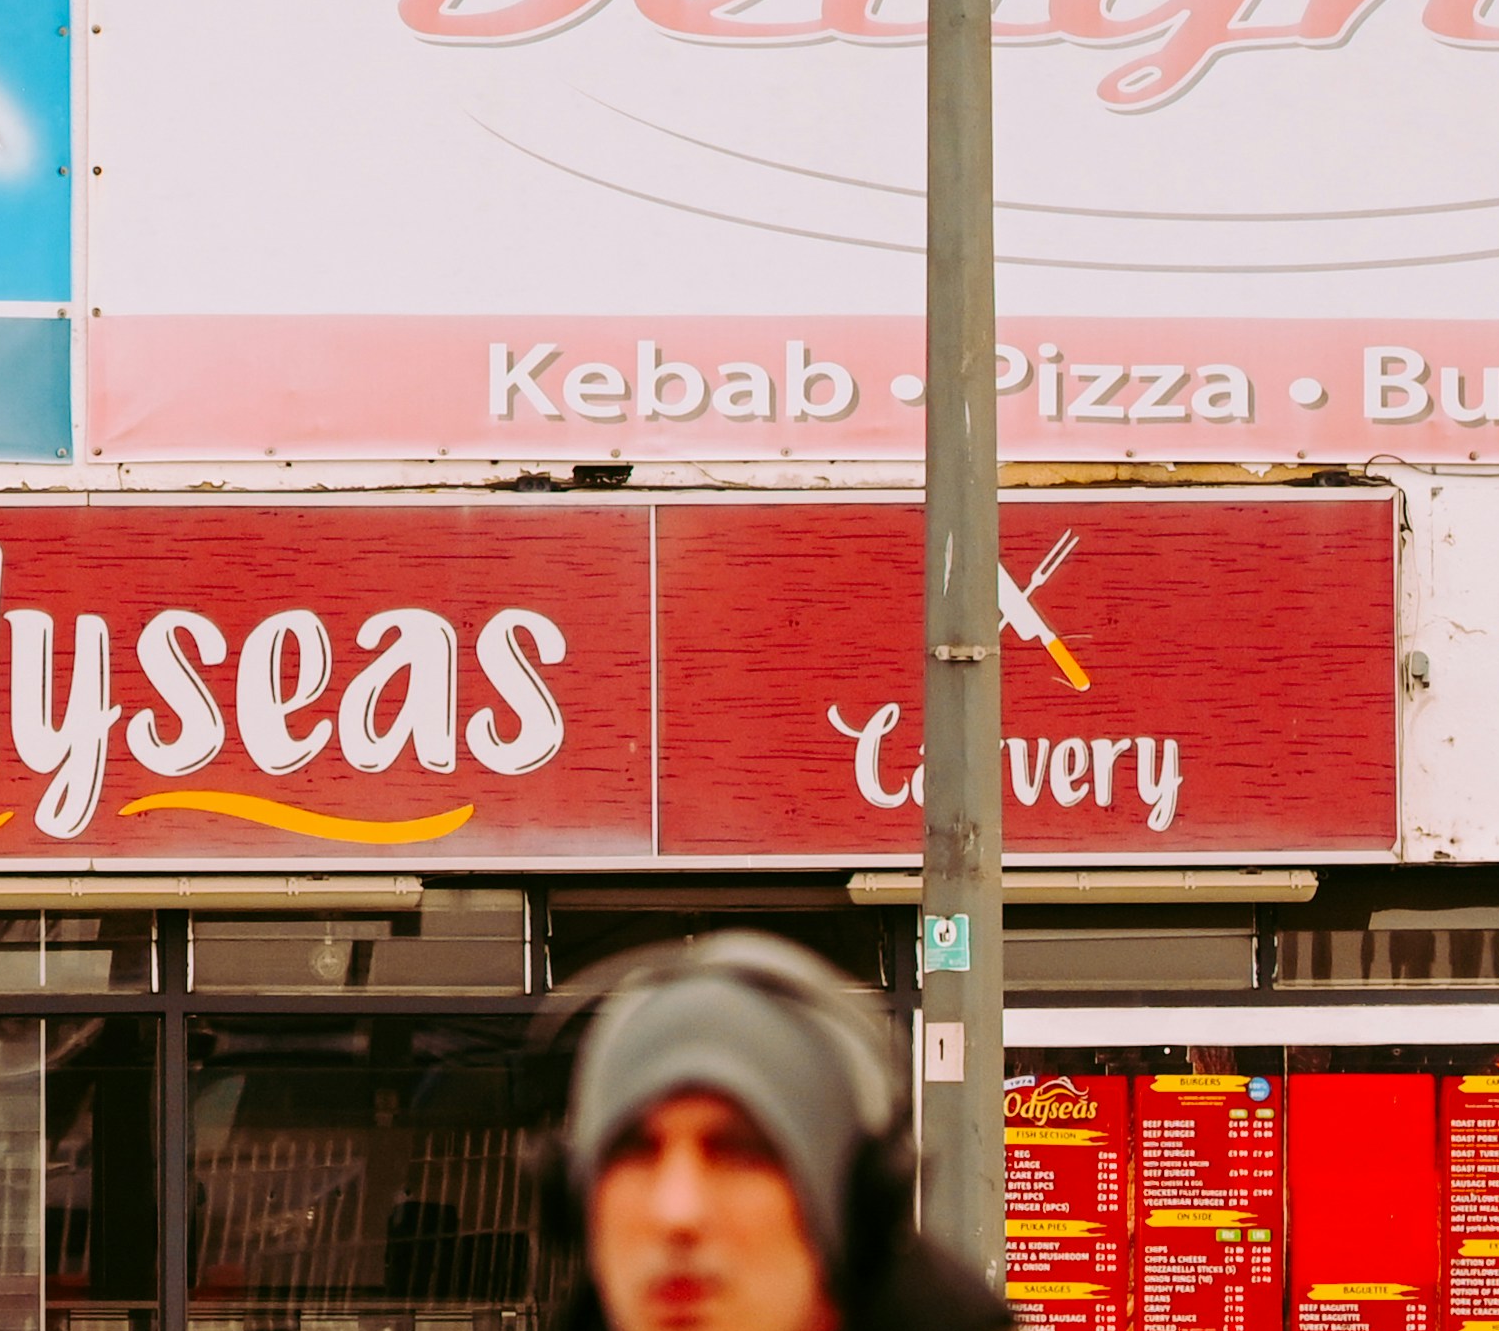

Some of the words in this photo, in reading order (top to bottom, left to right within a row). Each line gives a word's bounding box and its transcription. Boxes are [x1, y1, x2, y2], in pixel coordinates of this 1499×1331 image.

[489, 342, 859, 420] Kebab
[827, 702, 1183, 832] Cvery
[938, 1038, 944, 1061] 1
[1180, 1078, 1221, 1086] BURGERS
[1004, 1088, 1098, 1126] Odyseas
[1039, 1131, 1076, 1139] SECTION
